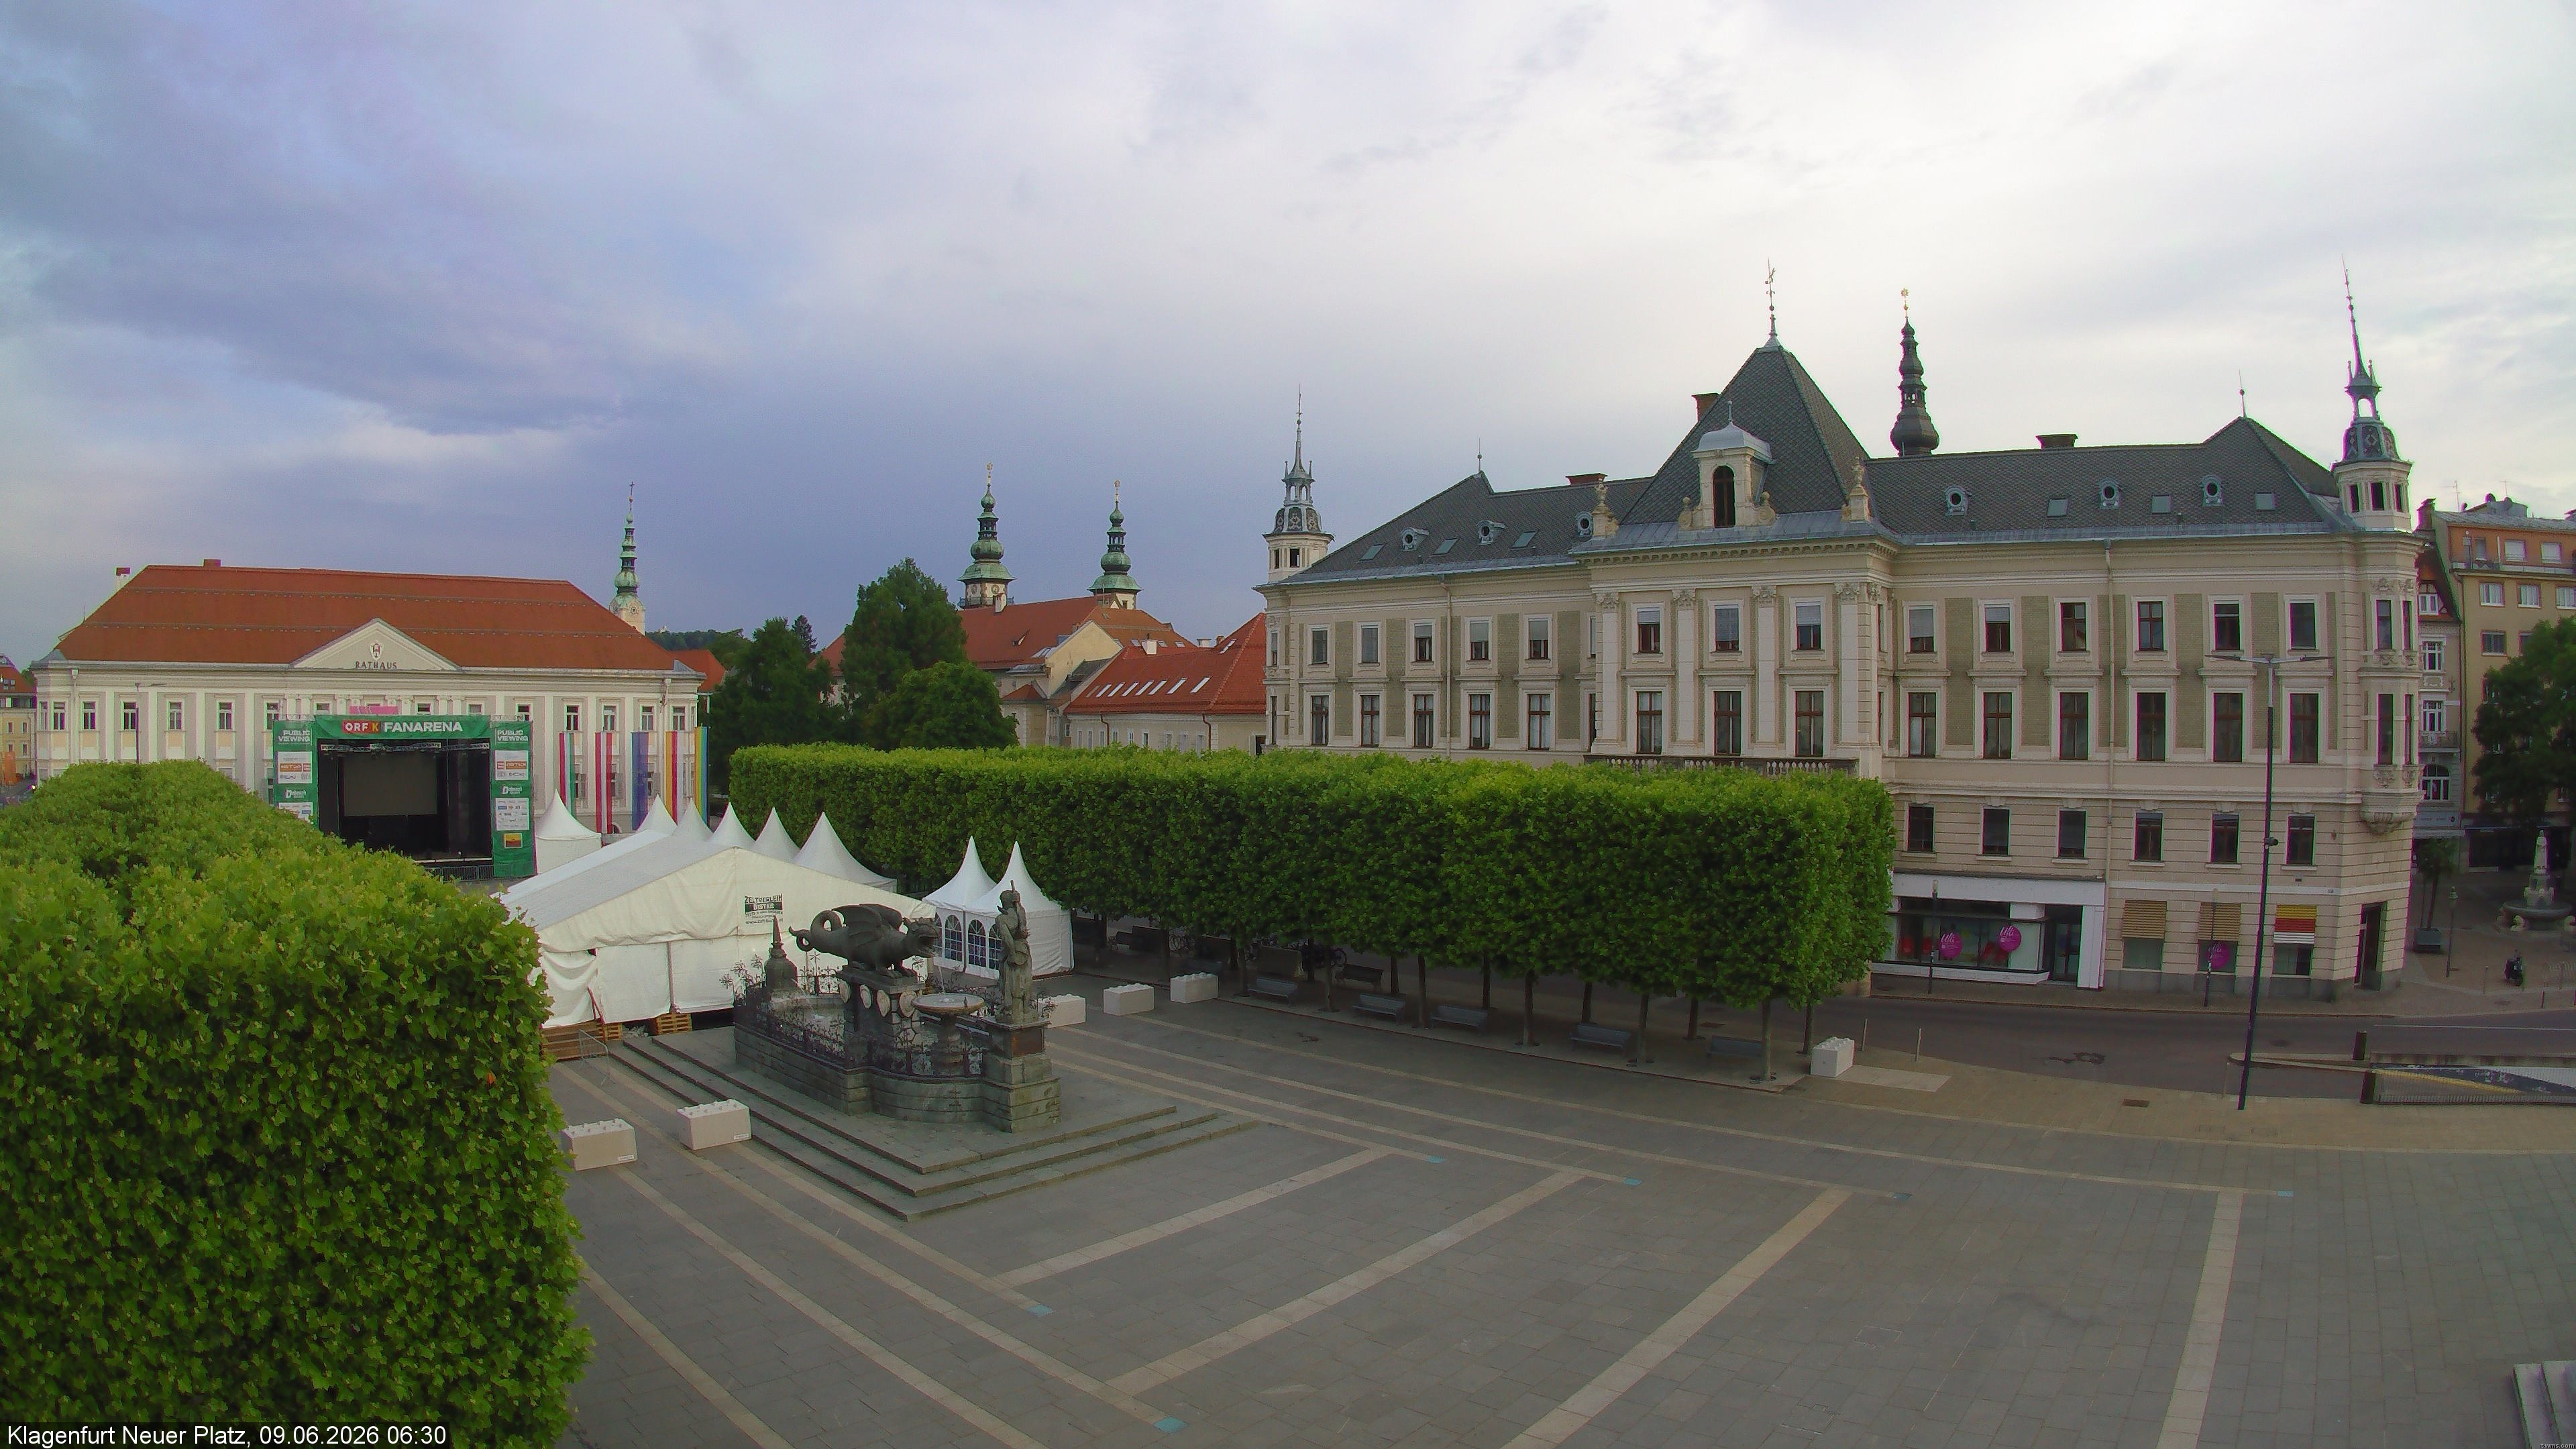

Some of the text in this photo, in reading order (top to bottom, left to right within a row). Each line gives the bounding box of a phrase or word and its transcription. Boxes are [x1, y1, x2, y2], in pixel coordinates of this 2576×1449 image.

[356, 661, 397, 669] RATHAUS
[345, 722, 368, 731] ORF
[384, 722, 464, 733] FANARENA
[745, 894, 782, 904] ZELTVERLEIH
